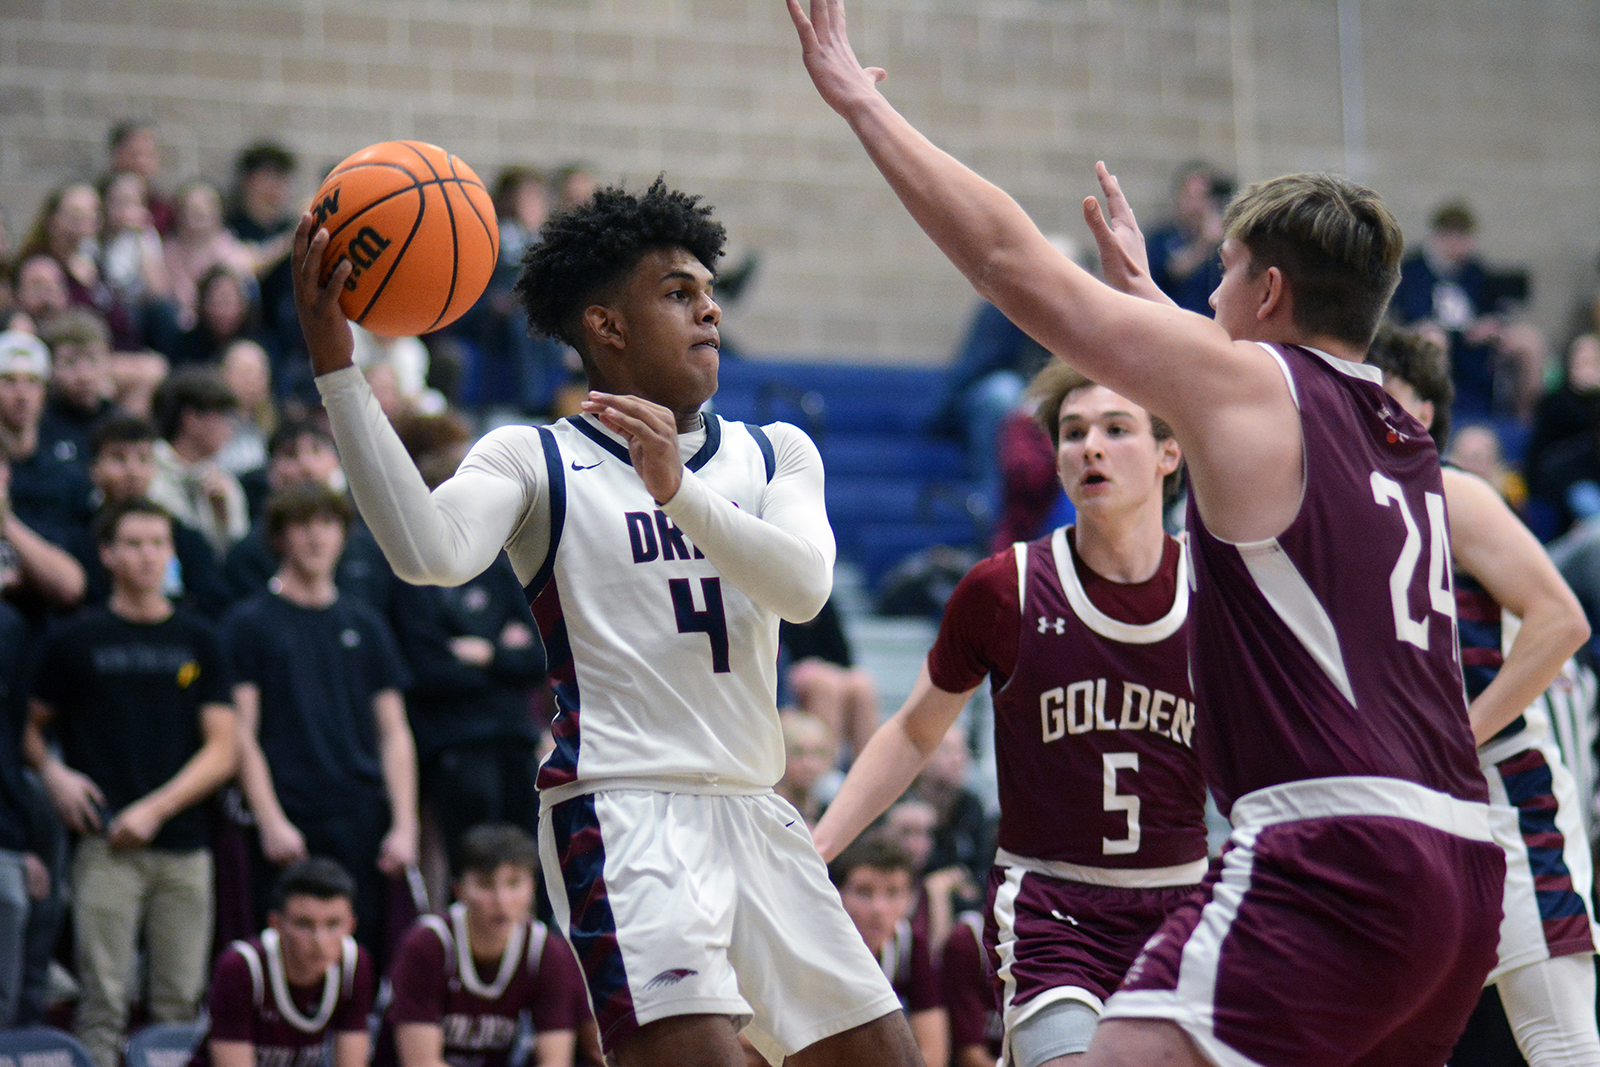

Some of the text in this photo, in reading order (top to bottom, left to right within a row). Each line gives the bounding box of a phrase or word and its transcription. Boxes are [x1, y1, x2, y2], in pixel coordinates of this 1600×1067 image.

[1369, 470, 1457, 662] 24
[668, 577, 731, 673] 4
[1040, 678, 1195, 748] GOLDEN
[1102, 752, 1141, 855] 5
